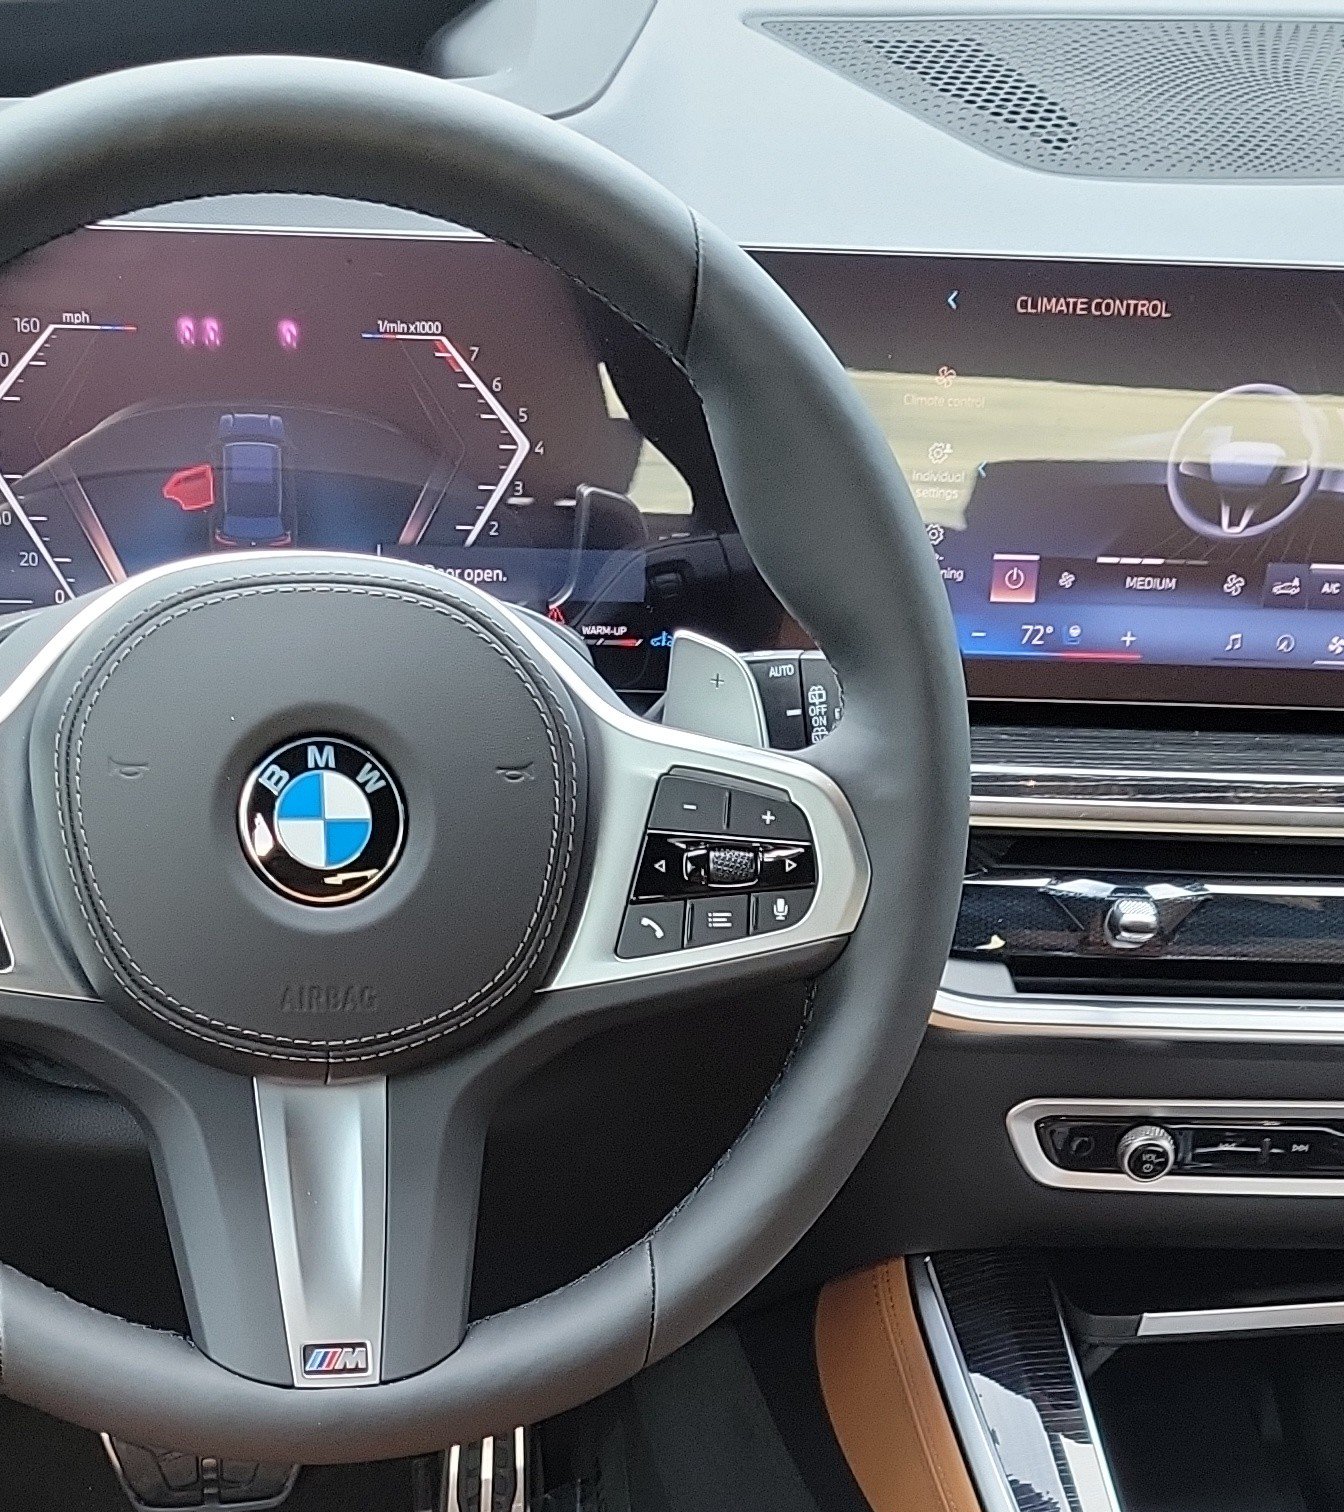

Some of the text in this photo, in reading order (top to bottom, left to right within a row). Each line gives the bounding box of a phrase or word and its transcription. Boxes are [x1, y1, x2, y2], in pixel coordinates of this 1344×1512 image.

[1016, 296, 1171, 318] CLIMATE CONTROL
[13, 317, 40, 333] 160
[62, 311, 90, 325] mph
[469, 347, 479, 361] 7
[491, 377, 502, 391] 6
[903, 393, 986, 408] Climate control
[518, 408, 528, 423] 5
[534, 441, 544, 455] 4
[912, 469, 965, 482] Individual
[514, 482, 523, 496] 3
[915, 488, 958, 500] settings
[489, 522, 499, 536] 2
[19, 552, 39, 567] 20
[463, 567, 508, 585] open.
[1125, 576, 1177, 590] MEDIUM
[1321, 582, 1342, 594] A/C
[581, 625, 628, 636] WARM-UP
[768, 664, 795, 678] AUTO
[808, 704, 828, 716] OFF
[811, 716, 827, 726] ON
[258, 745, 387, 797] BMW
[280, 984, 378, 1013] AIRBAG
